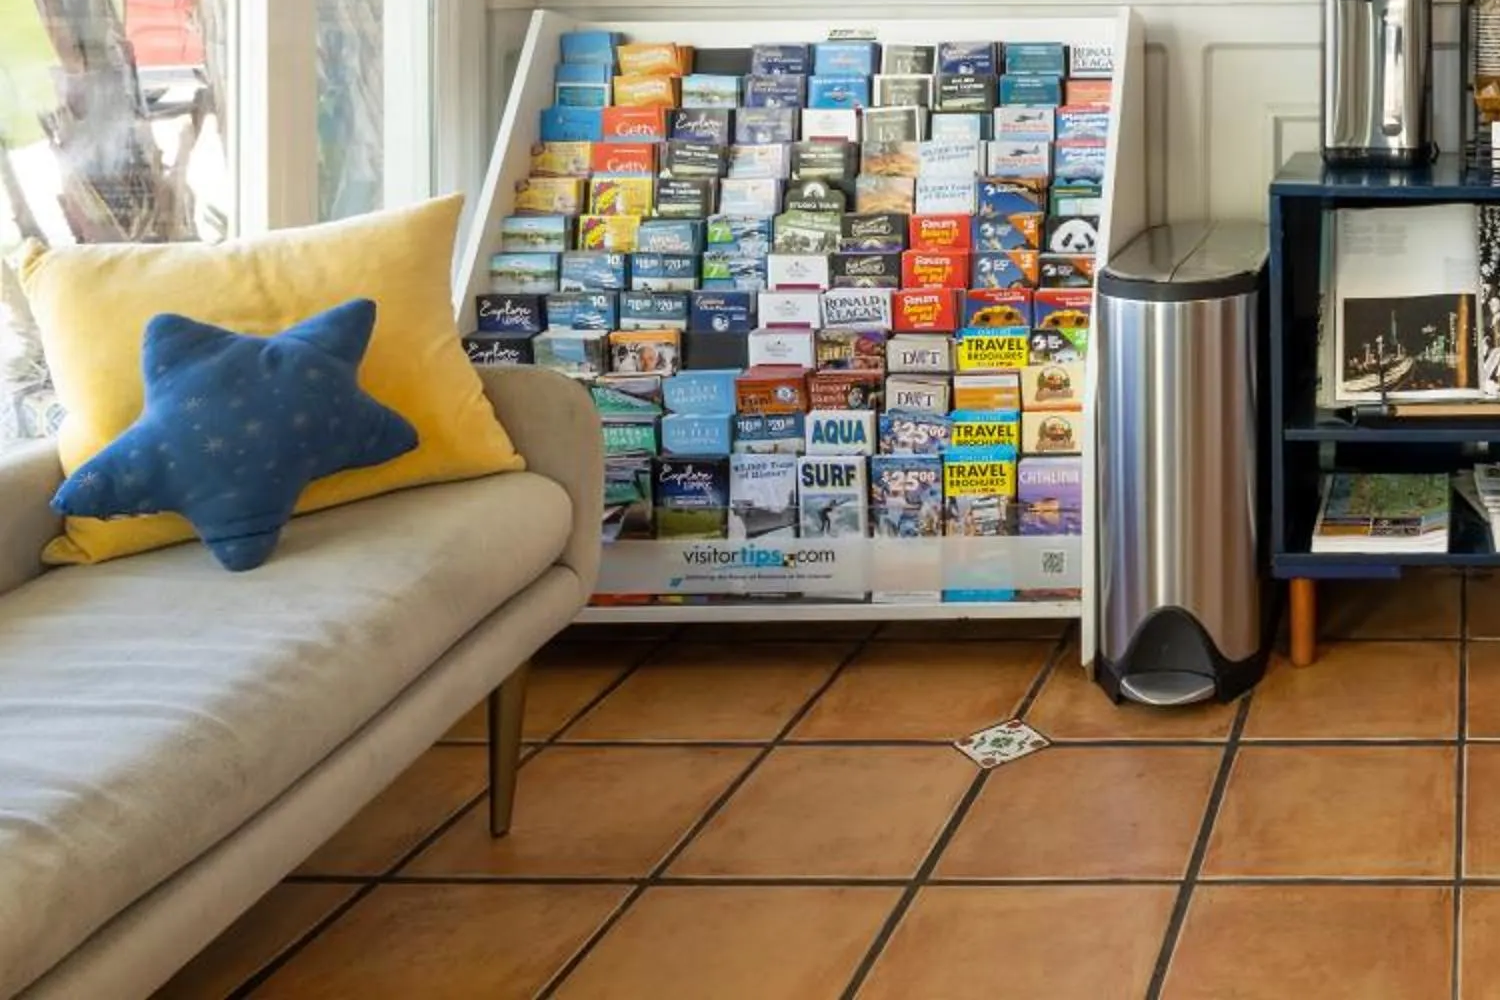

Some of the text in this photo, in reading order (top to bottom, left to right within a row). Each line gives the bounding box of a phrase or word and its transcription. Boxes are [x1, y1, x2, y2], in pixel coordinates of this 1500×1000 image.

[616, 122, 656, 136] Getty
[607, 158, 647, 173] Getty
[825, 296, 880, 309] RONALD
[480, 300, 531, 321] Explore
[826, 307, 881, 321] REAGAN
[966, 339, 1024, 350] TRAVEL
[967, 352, 1023, 360] BROCHURES
[812, 420, 867, 444] AQUA
[956, 425, 1014, 437] TRAVEL
[660, 464, 712, 485] Explore
[801, 463, 856, 487] SURF
[949, 465, 1006, 477] TRAVEL
[950, 478, 1006, 487] BROCHURES
